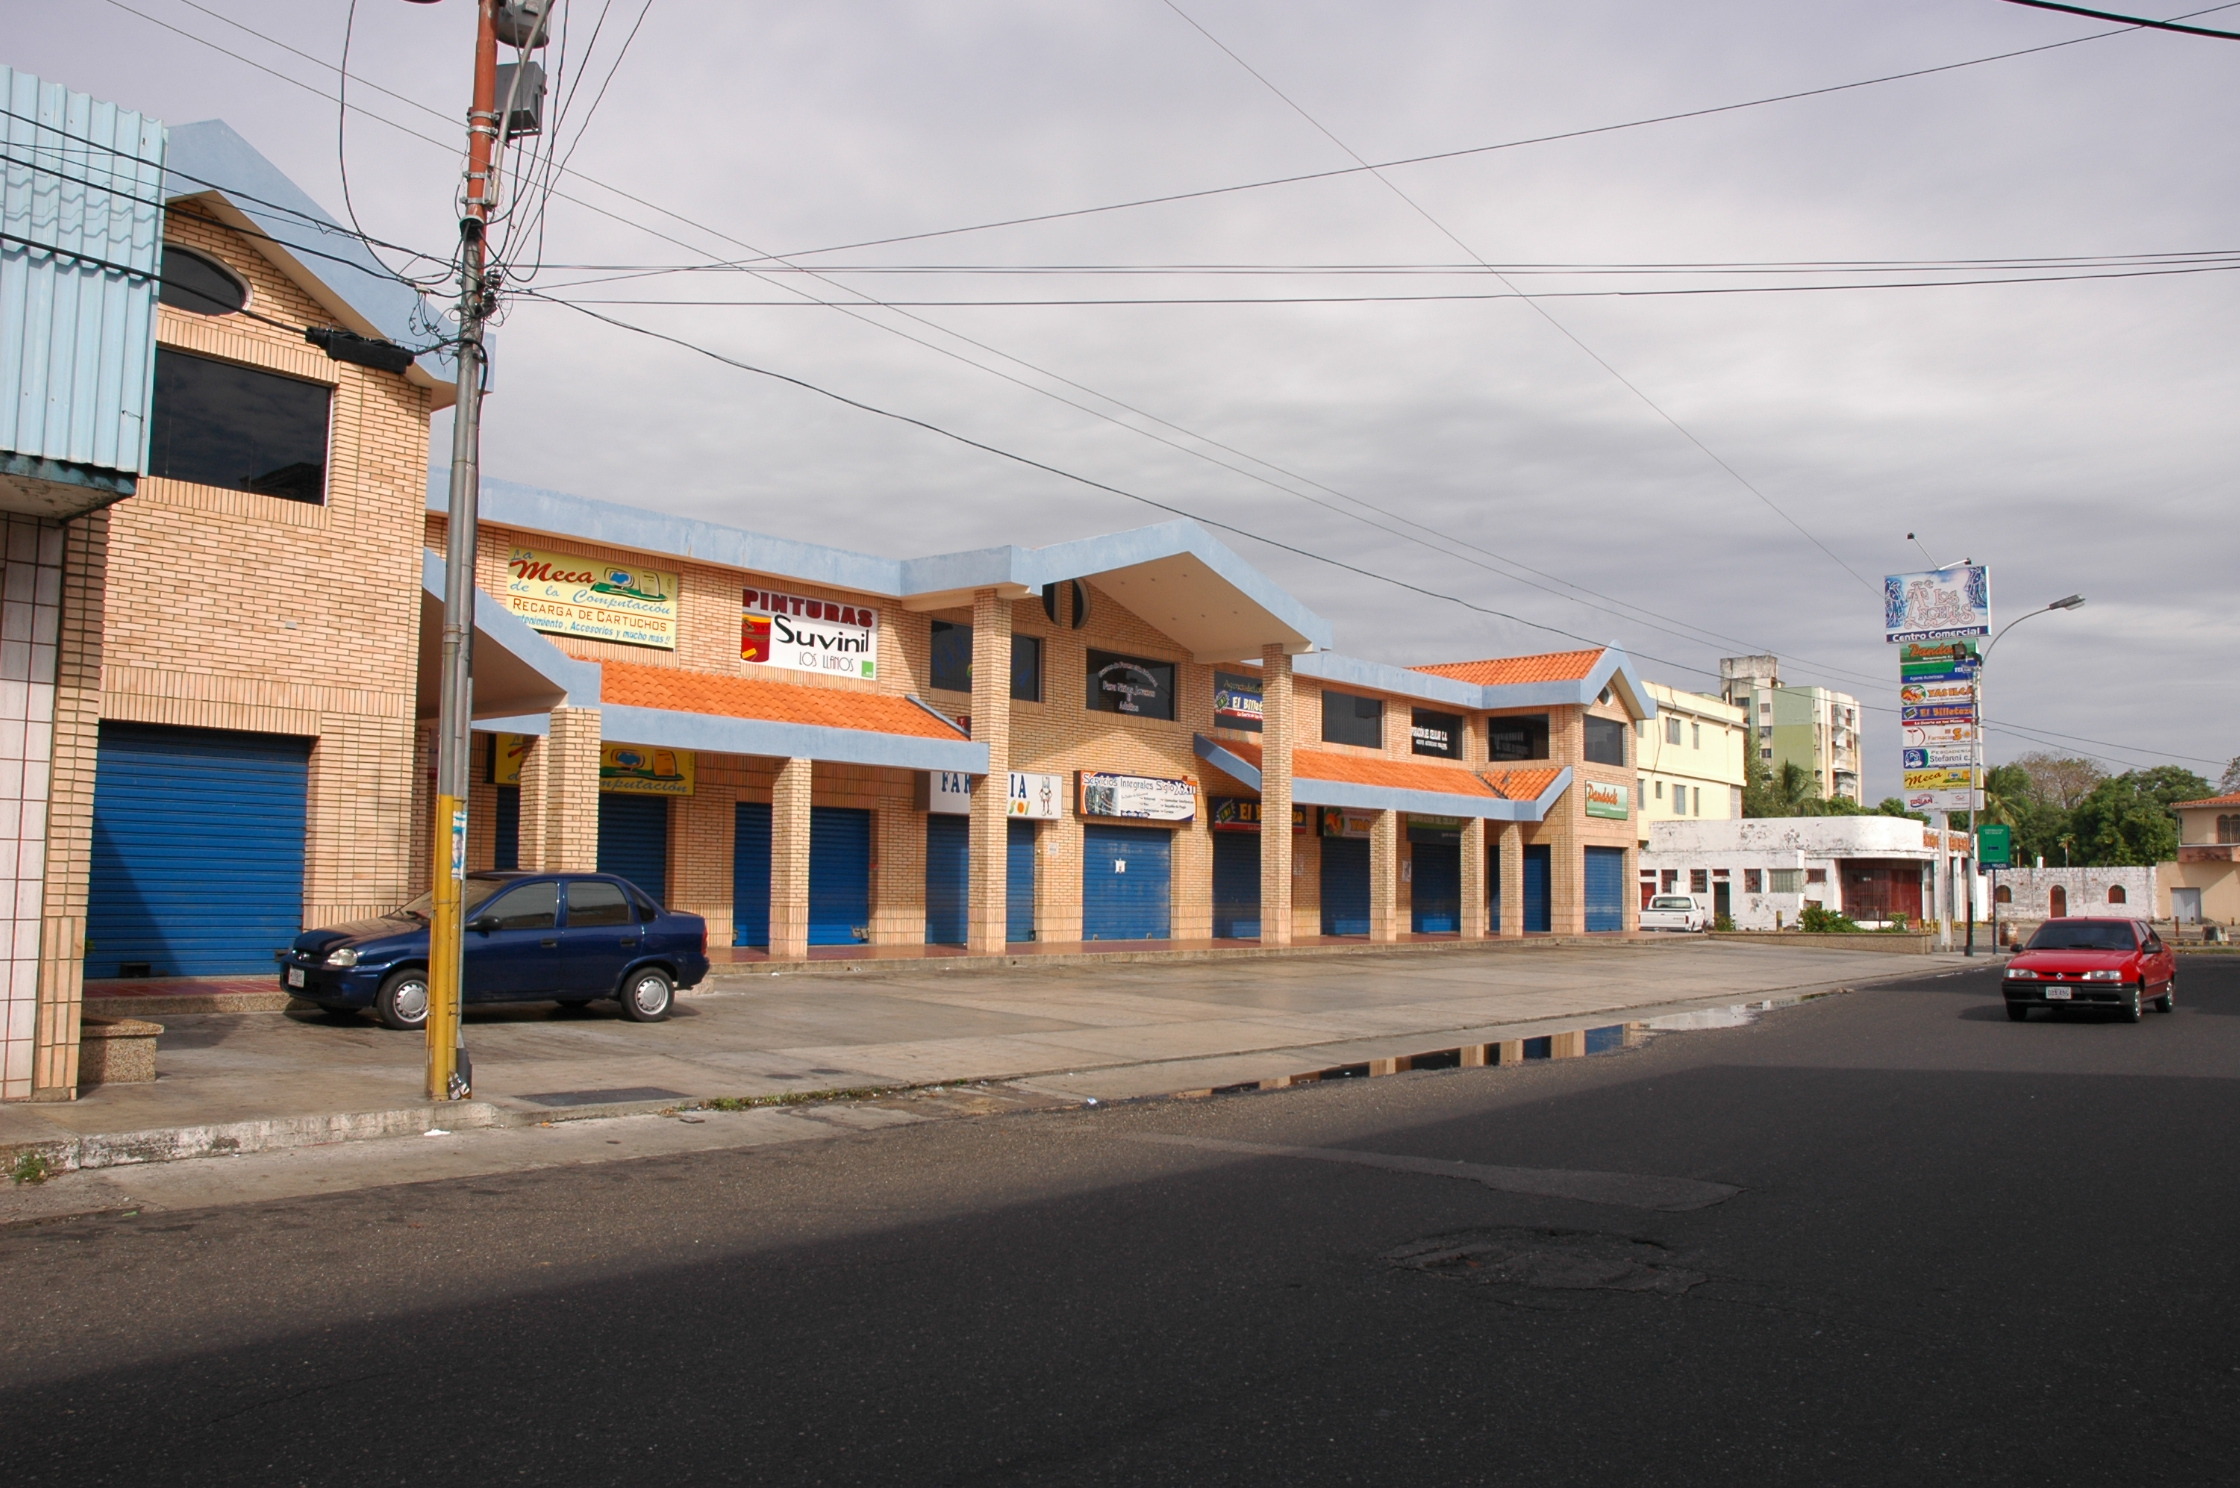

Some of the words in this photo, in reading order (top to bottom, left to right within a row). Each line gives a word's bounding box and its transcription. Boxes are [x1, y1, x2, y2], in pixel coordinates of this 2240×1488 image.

[510, 549, 535, 561] La
[509, 559, 598, 584] Meca
[509, 580, 529, 593] de
[545, 584, 560, 597] la
[572, 589, 672, 615] Computación
[512, 597, 573, 618] RECARGA
[578, 609, 593, 621] DE
[596, 610, 667, 632] CARTUCHOS
[742, 588, 873, 628] PINTURAS
[570, 622, 613, 636] Accesorios
[622, 629, 647, 642] mucho
[773, 614, 869, 653] Suvinil
[1892, 632, 1926, 643] Centro
[1928, 628, 1980, 639] Comercial
[799, 651, 817, 668] LOS
[822, 654, 855, 672] LLANOS
[1232, 696, 1241, 709] El
[1083, 774, 1118, 788] Servicios
[1120, 777, 1154, 792] Integrales
[1155, 780, 1175, 794] Siglo
[1904, 771, 1943, 786] Meca
